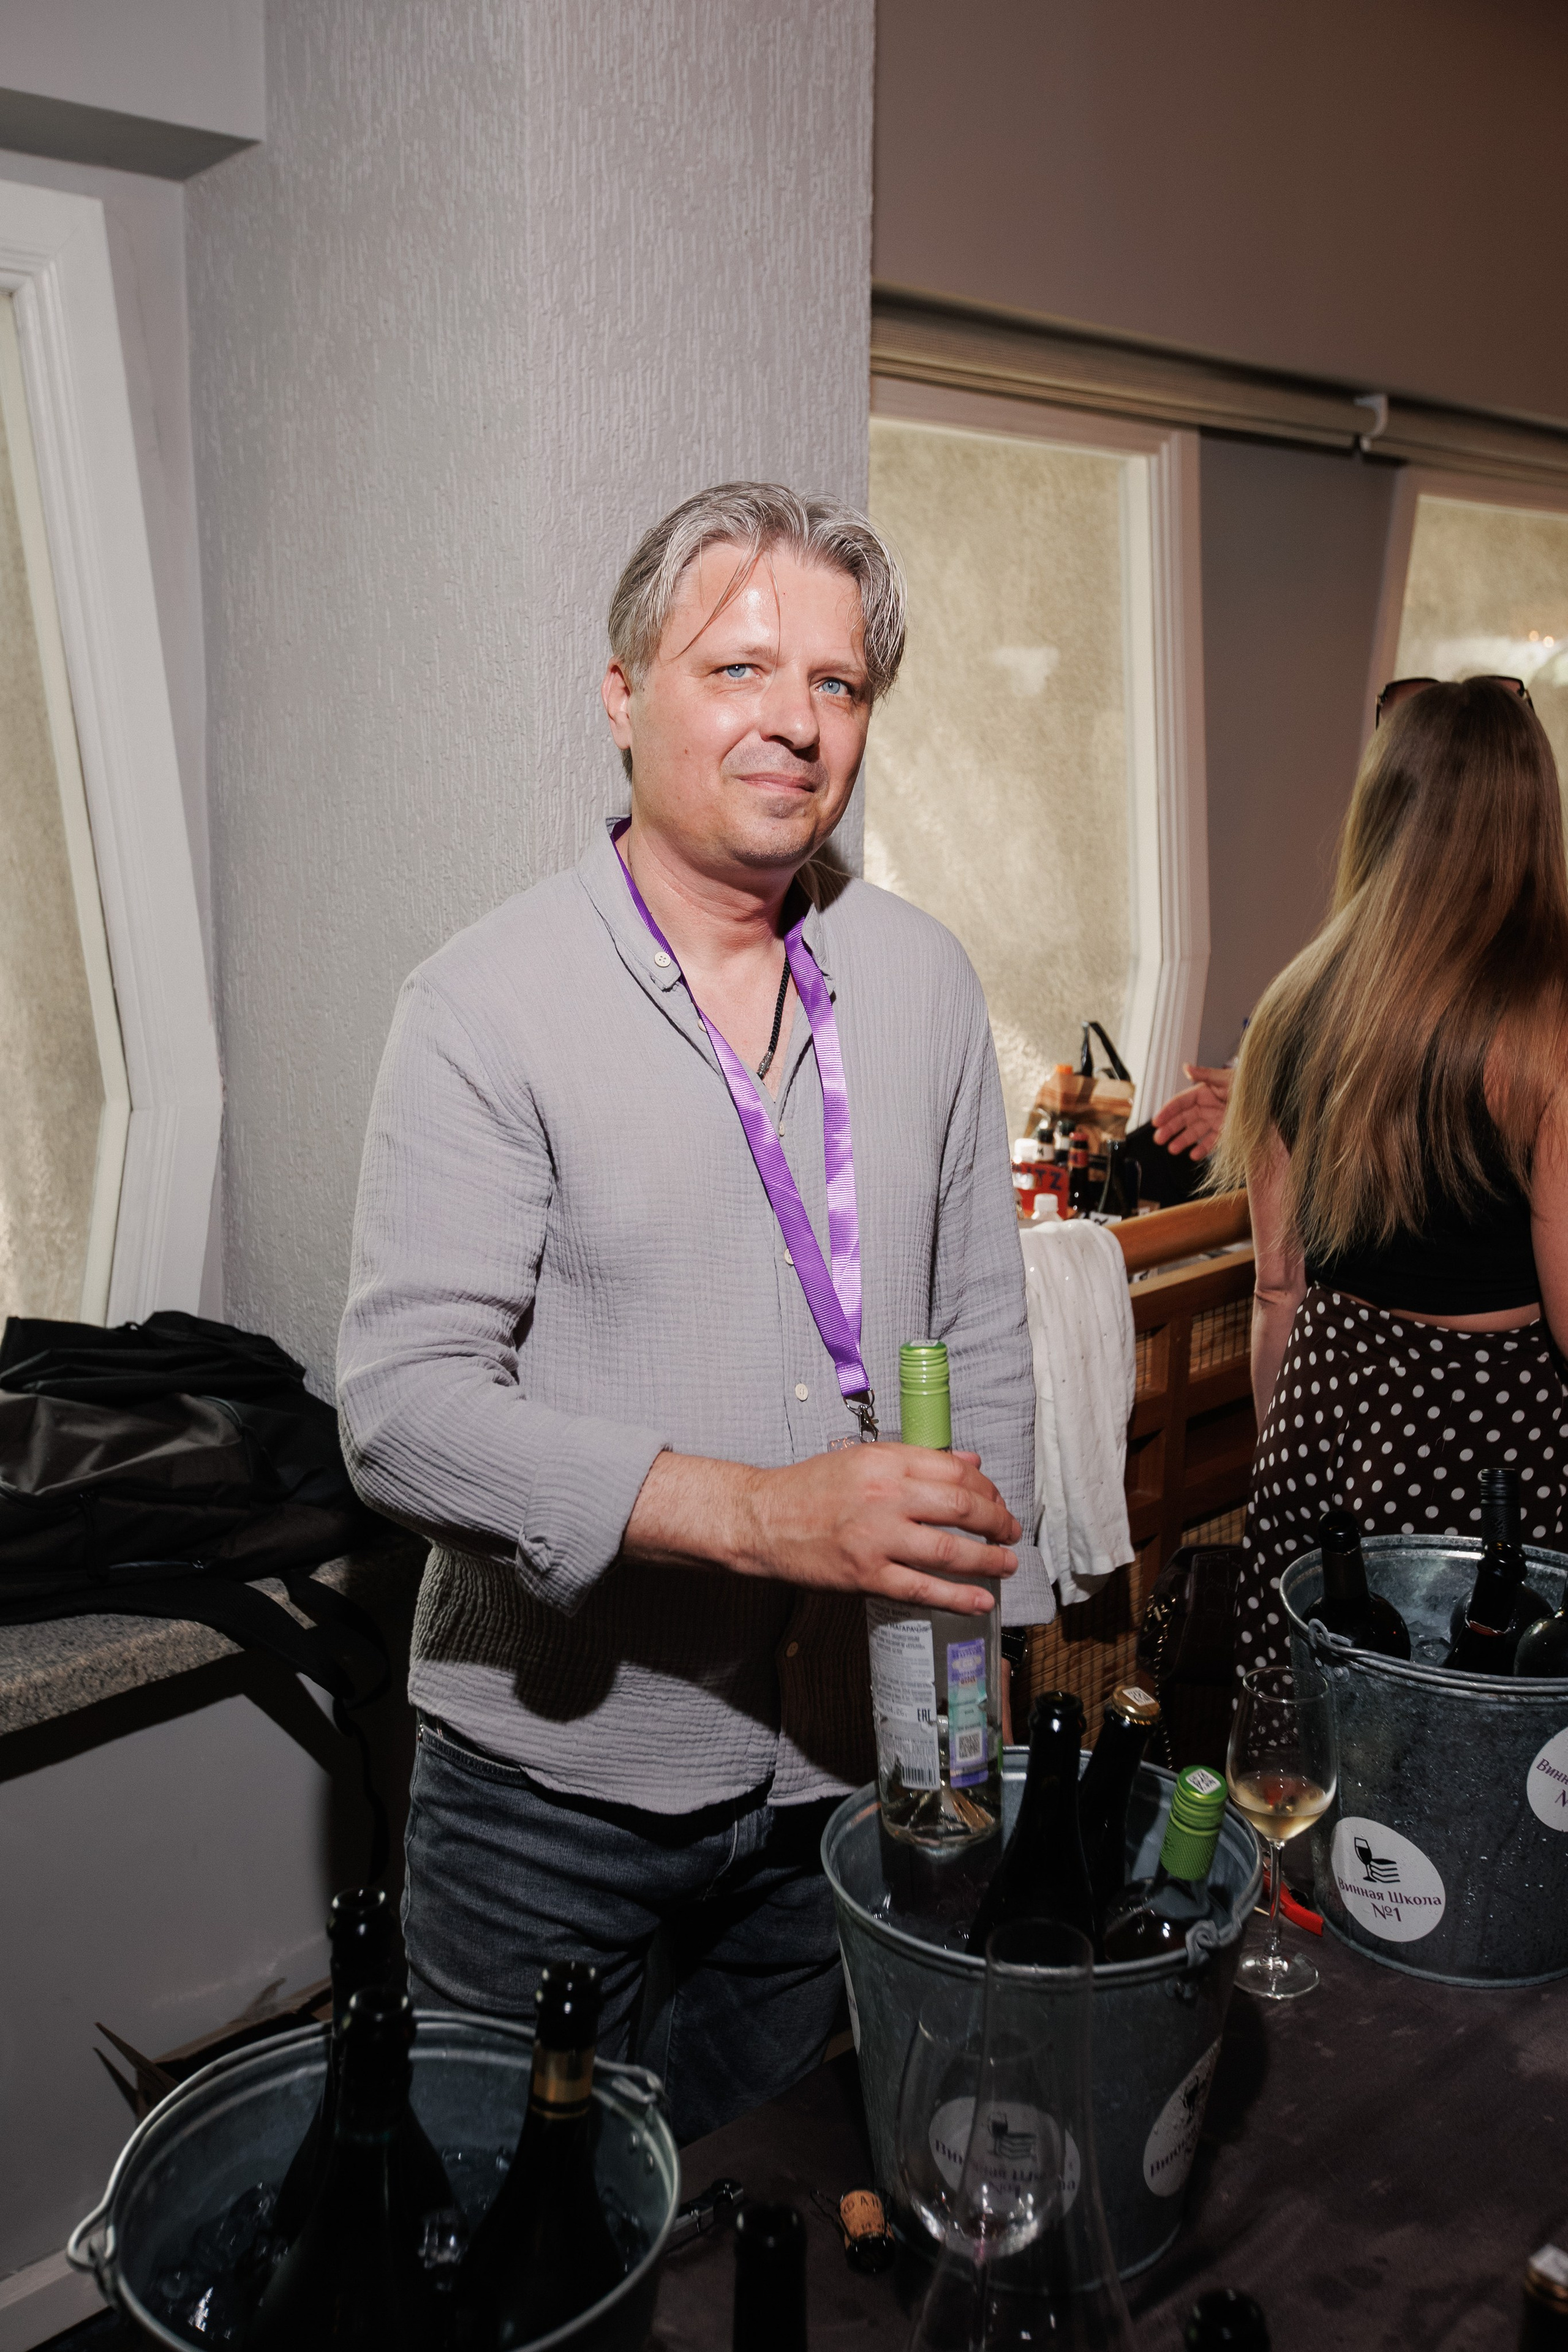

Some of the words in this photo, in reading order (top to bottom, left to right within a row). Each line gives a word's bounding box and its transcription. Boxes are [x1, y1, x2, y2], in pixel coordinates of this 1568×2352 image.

[1338, 1876, 1384, 1901] Винная
[1388, 1891, 1442, 1906] Школа
[1370, 1902, 1402, 1923] №1
